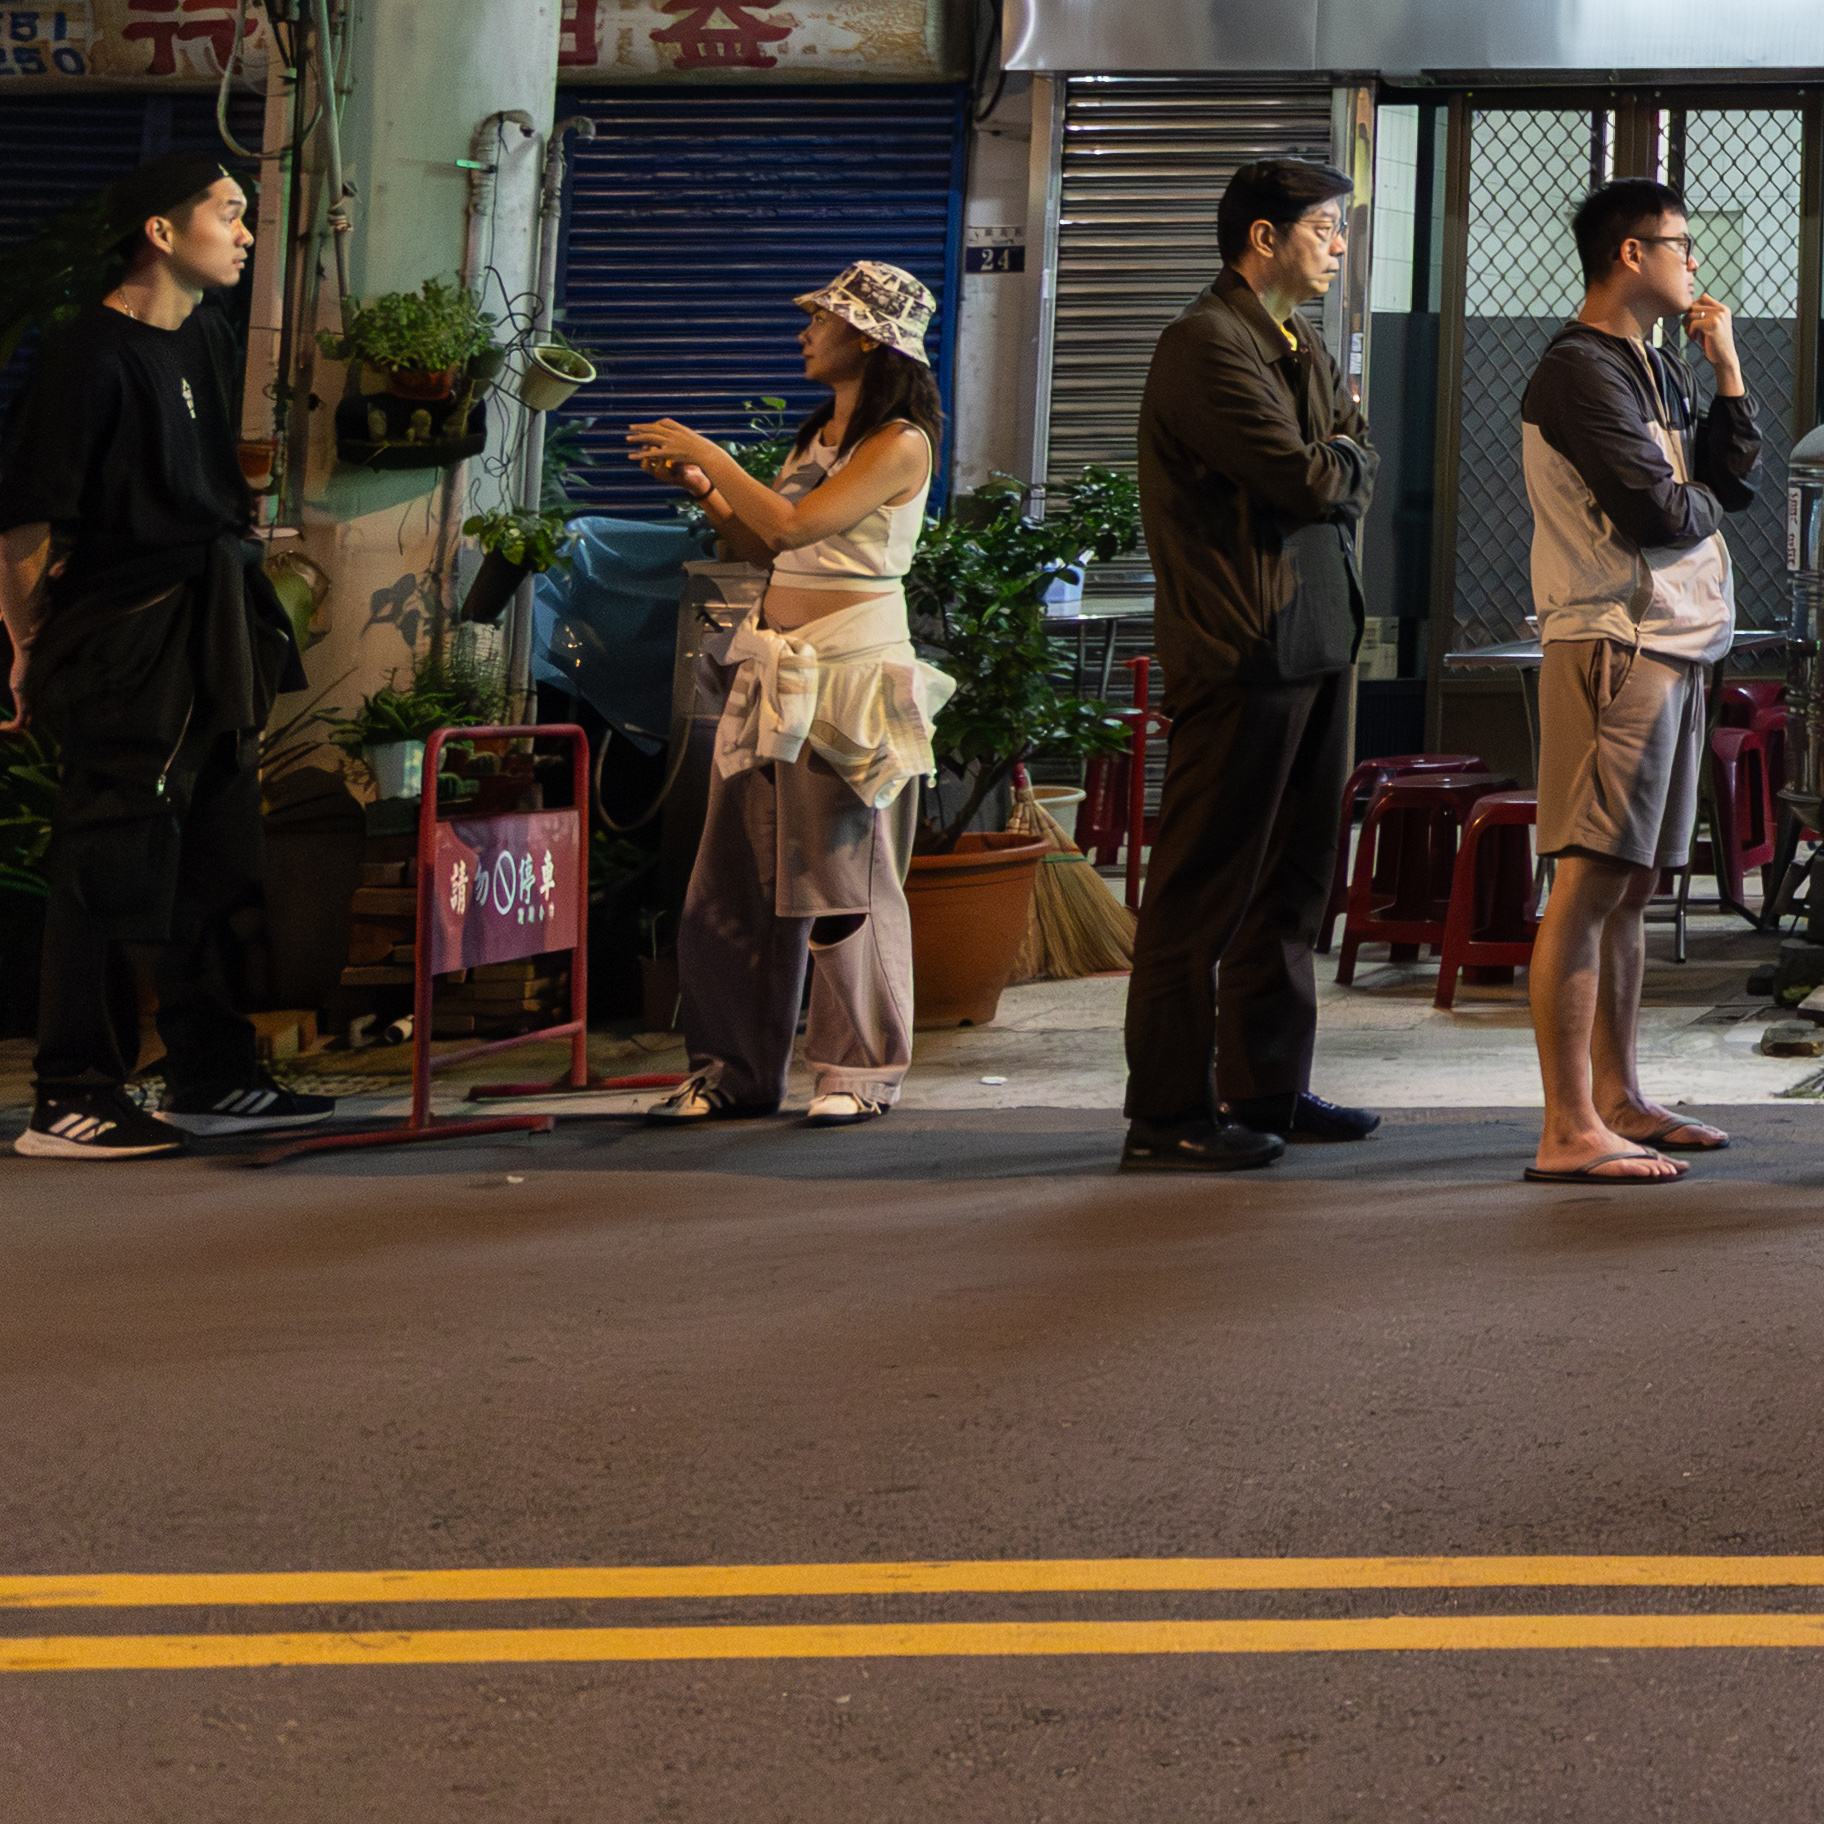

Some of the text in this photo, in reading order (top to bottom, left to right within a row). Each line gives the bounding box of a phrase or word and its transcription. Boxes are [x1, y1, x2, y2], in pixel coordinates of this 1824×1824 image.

[980, 248, 1010, 271] 24
[450, 849, 556, 916] 請勿停車
